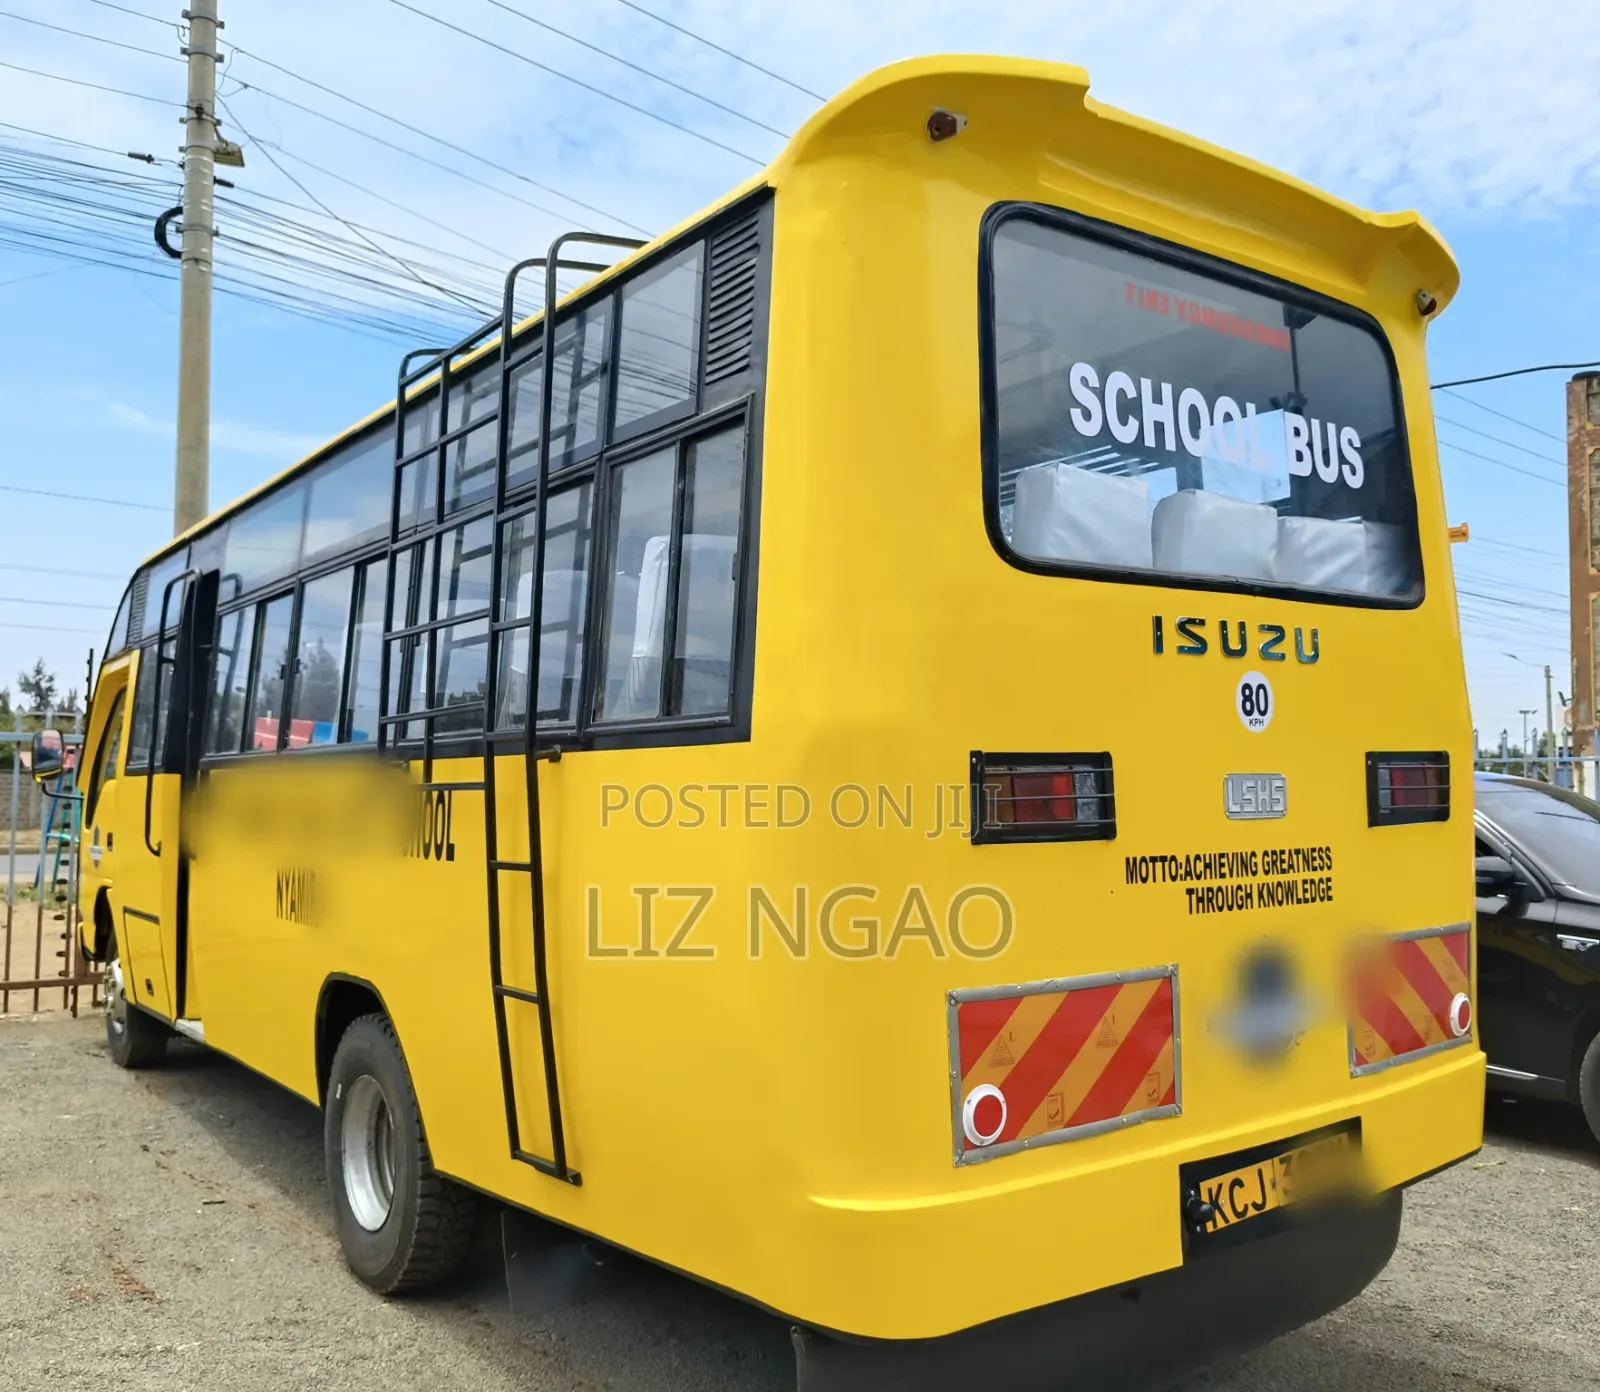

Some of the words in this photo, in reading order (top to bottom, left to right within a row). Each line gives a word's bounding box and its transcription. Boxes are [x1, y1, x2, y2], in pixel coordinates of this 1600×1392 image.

[1069, 362, 1274, 471] SCHOOL
[1284, 411, 1365, 489] BUS
[1152, 614, 1320, 663] ISUZU
[1241, 683, 1268, 717] 80
[1248, 718, 1264, 727] KPH
[1262, 846, 1333, 876] GREATNESS
[1186, 883, 1254, 915] THROUGH
[1257, 877, 1334, 909] KNOWLEDGE
[1207, 1167, 1267, 1230] KCJ
